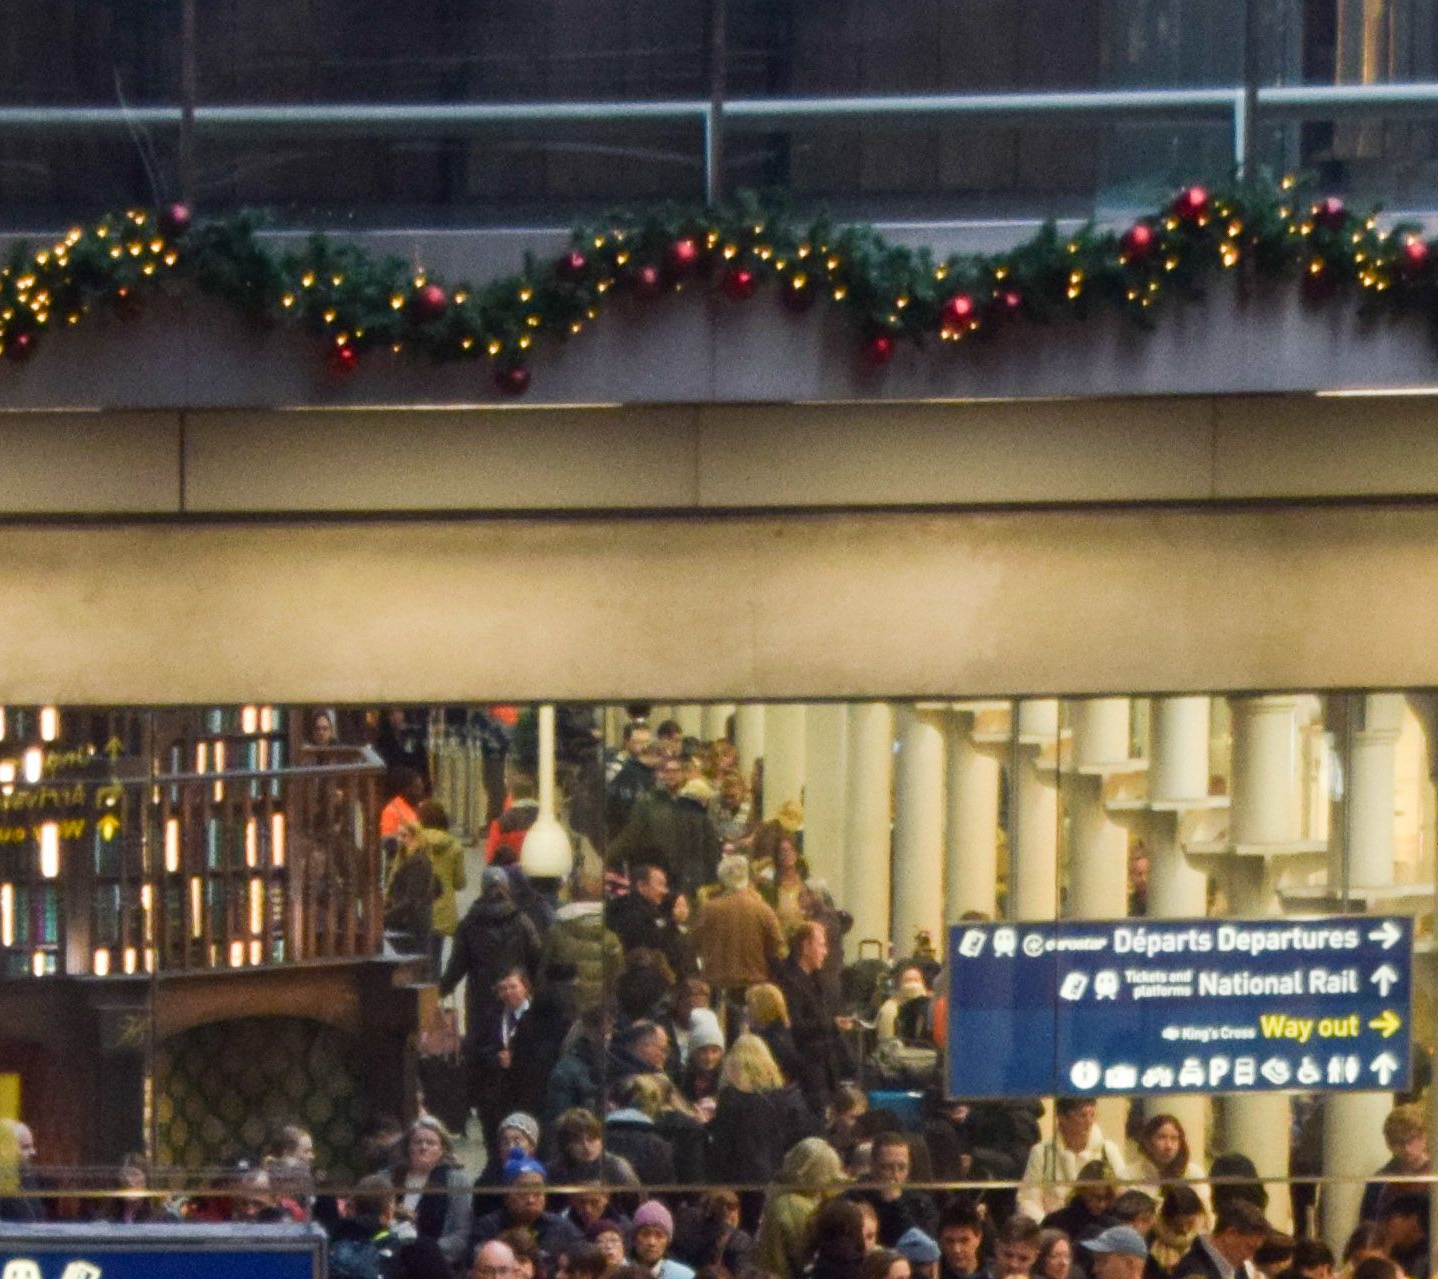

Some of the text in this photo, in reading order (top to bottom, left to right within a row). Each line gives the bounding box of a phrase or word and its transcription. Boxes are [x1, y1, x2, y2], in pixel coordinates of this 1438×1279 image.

[1114, 928, 1213, 957] Départs
[1217, 925, 1359, 955] Departures
[1125, 970, 1192, 985] Tickets and
[1198, 968, 1358, 996] National Rail
[1133, 984, 1192, 999] platforms
[1221, 1026, 1255, 1039] Cross
[1260, 1014, 1359, 1043] Way out
